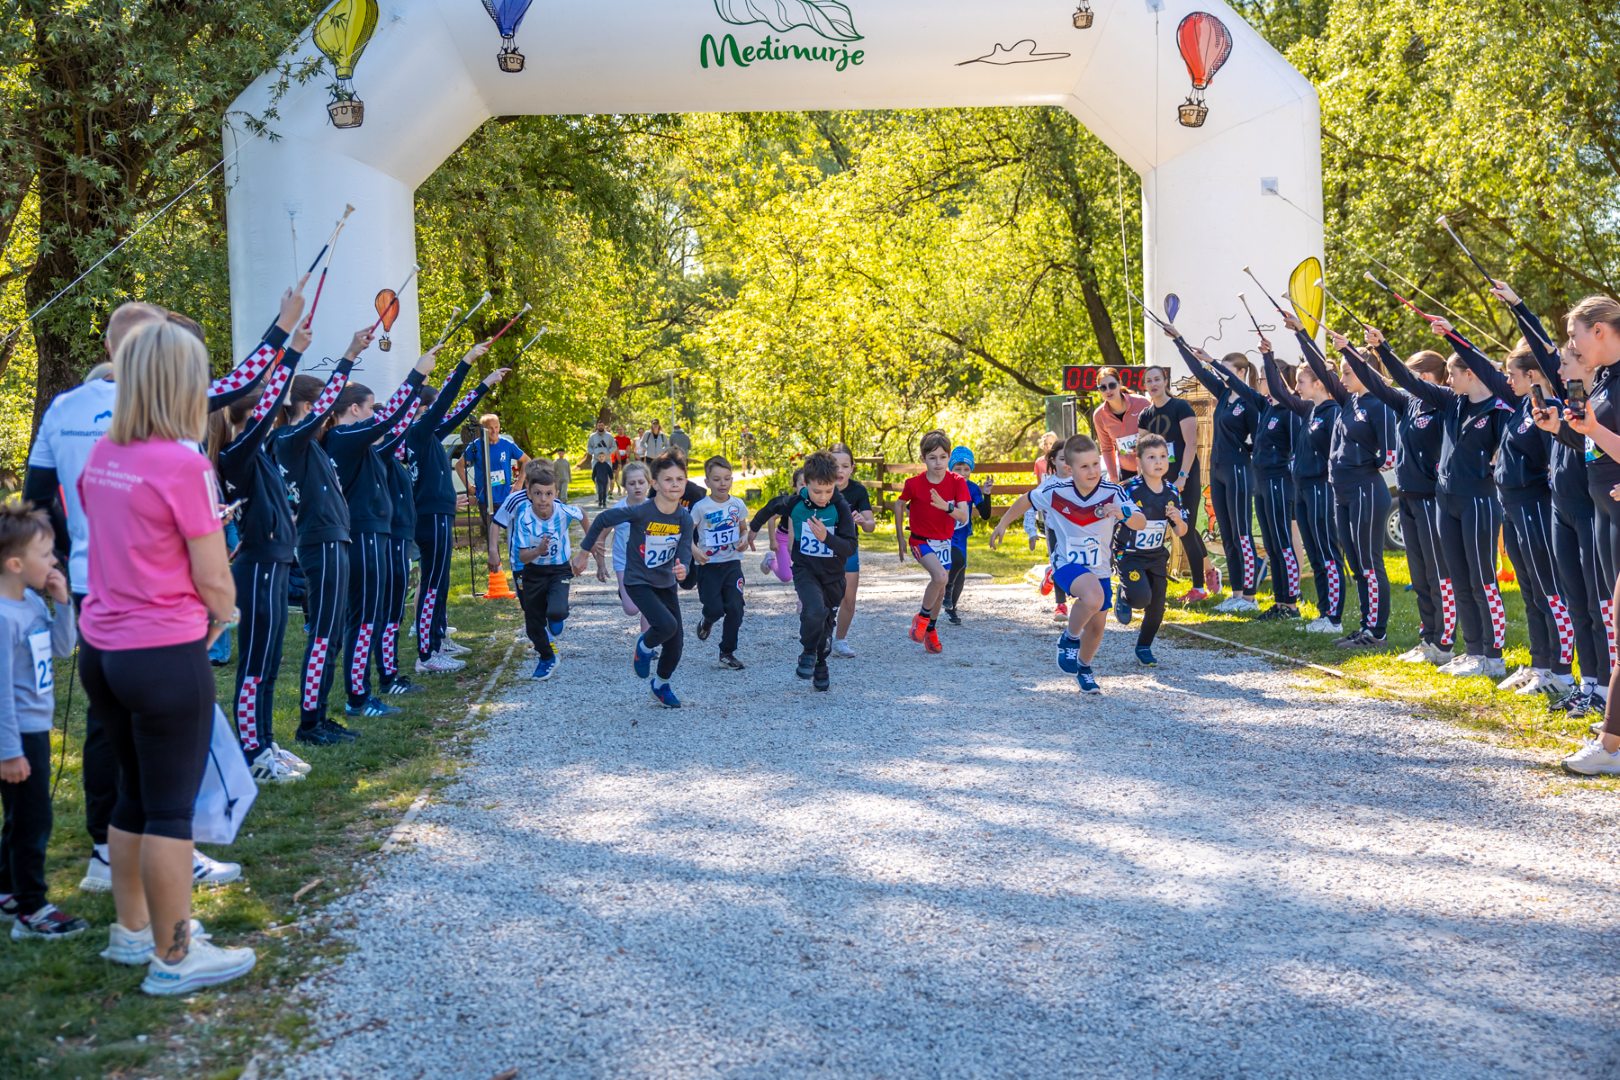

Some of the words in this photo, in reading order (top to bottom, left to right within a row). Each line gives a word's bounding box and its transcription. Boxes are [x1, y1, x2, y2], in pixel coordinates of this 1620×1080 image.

[712, 530, 735, 544] 157
[800, 536, 831, 554] 231
[1136, 532, 1163, 547] 249
[647, 547, 676, 565] 240
[1068, 549, 1099, 567] 217
